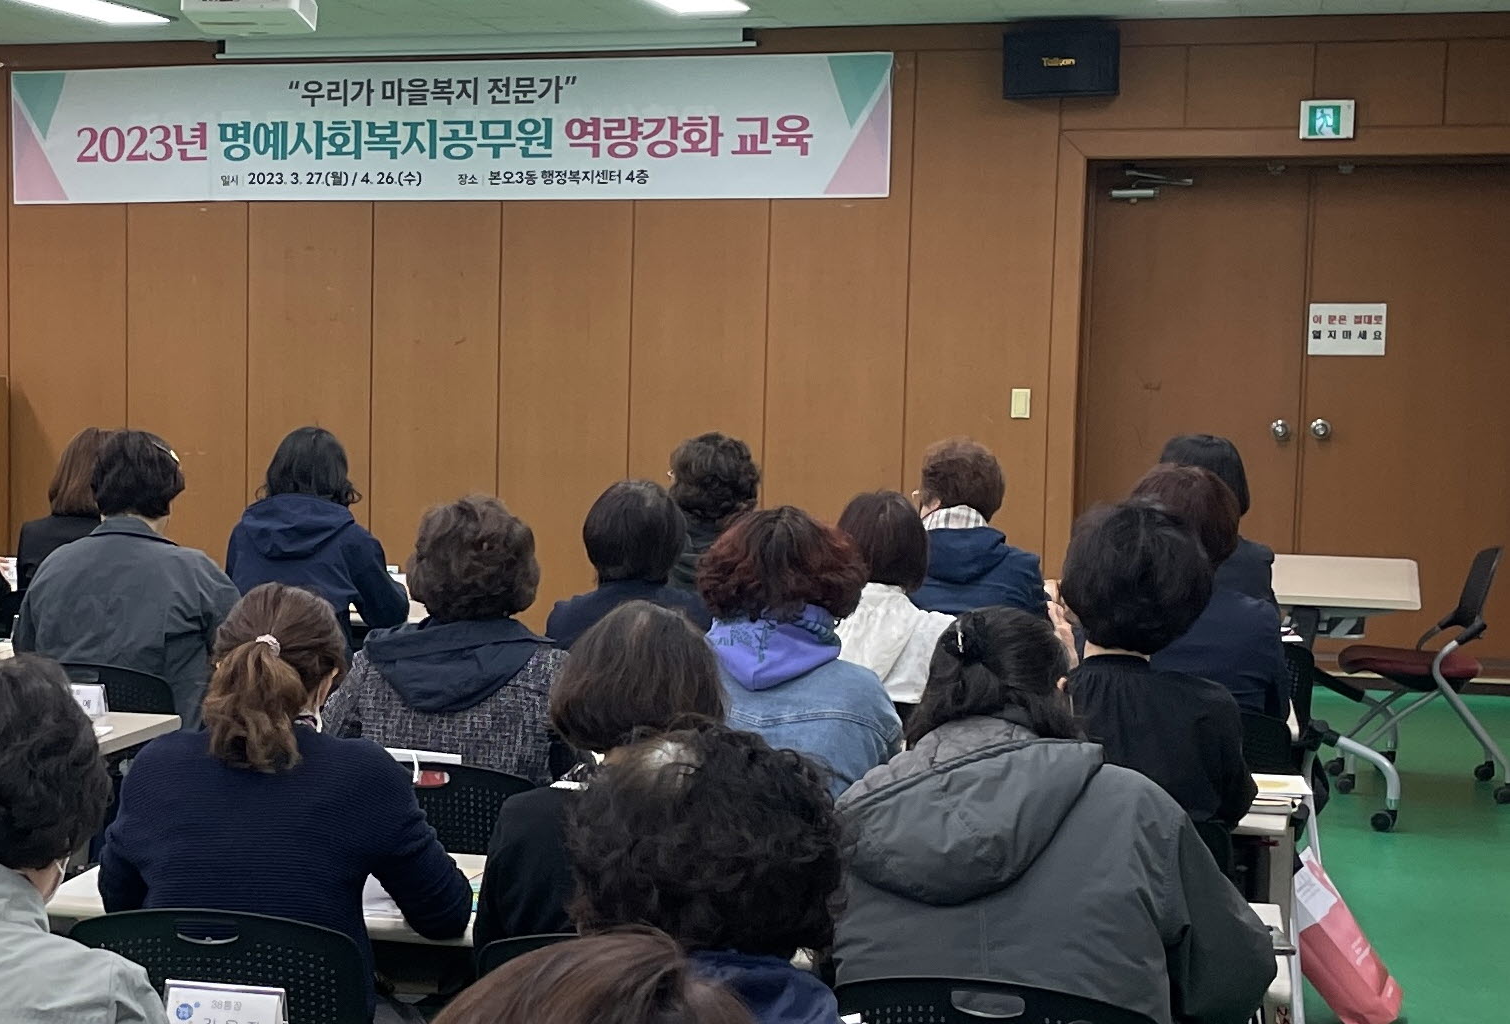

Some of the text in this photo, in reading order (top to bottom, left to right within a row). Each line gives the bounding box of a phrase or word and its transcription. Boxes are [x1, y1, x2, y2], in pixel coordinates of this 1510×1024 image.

[381, 76, 479, 106] 마을복지
[76, 113, 813, 163] 2023년 명예사회복지공무원 역량강화 교육
[220, 175, 239, 186] 일시
[457, 169, 650, 186] 장소 본오3동 행정복지센터 4층
[1312, 314, 1322, 325] 이
